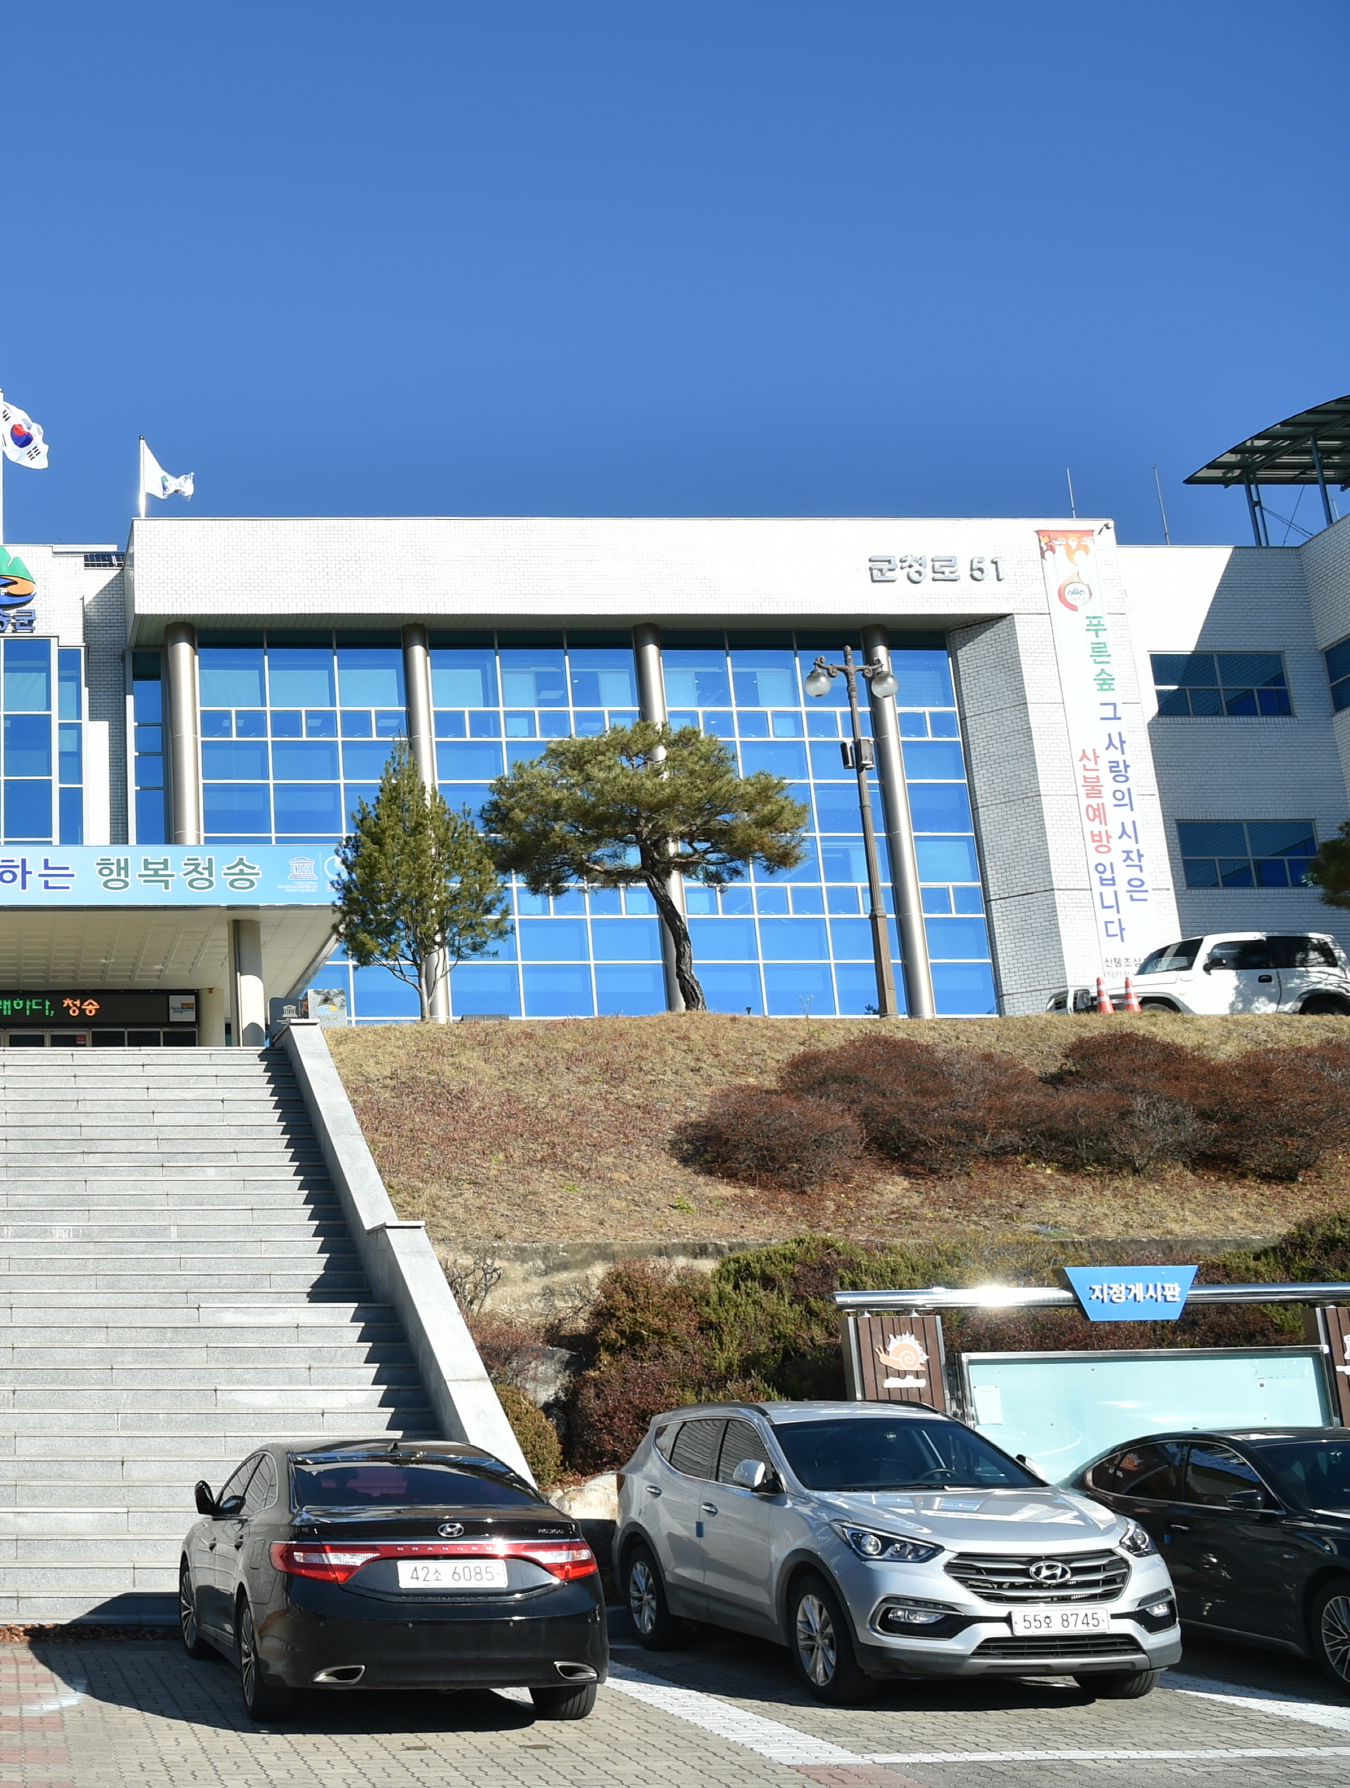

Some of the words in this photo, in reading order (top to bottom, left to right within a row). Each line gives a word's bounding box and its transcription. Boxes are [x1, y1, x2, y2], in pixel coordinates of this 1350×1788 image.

[869, 554, 961, 584] 군청로
[970, 556, 1005, 582] 51
[1085, 615, 1116, 692] 푸른숲
[1099, 702, 1122, 721] 그
[1105, 731, 1134, 812] 사랑의
[1078, 748, 1112, 854] 산불예방
[95, 856, 262, 892] 행복청송
[1118, 820, 1149, 902] 시작은
[1094, 862, 1126, 943] 입니다
[62, 997, 100, 1016] 청송
[1088, 1281, 1181, 1304] 지정게시판
[410, 1566, 442, 1582] 42소
[452, 1566, 495, 1582] 6085
[1023, 1614, 1053, 1630] 55호
[1061, 1612, 1100, 1629] 8745
